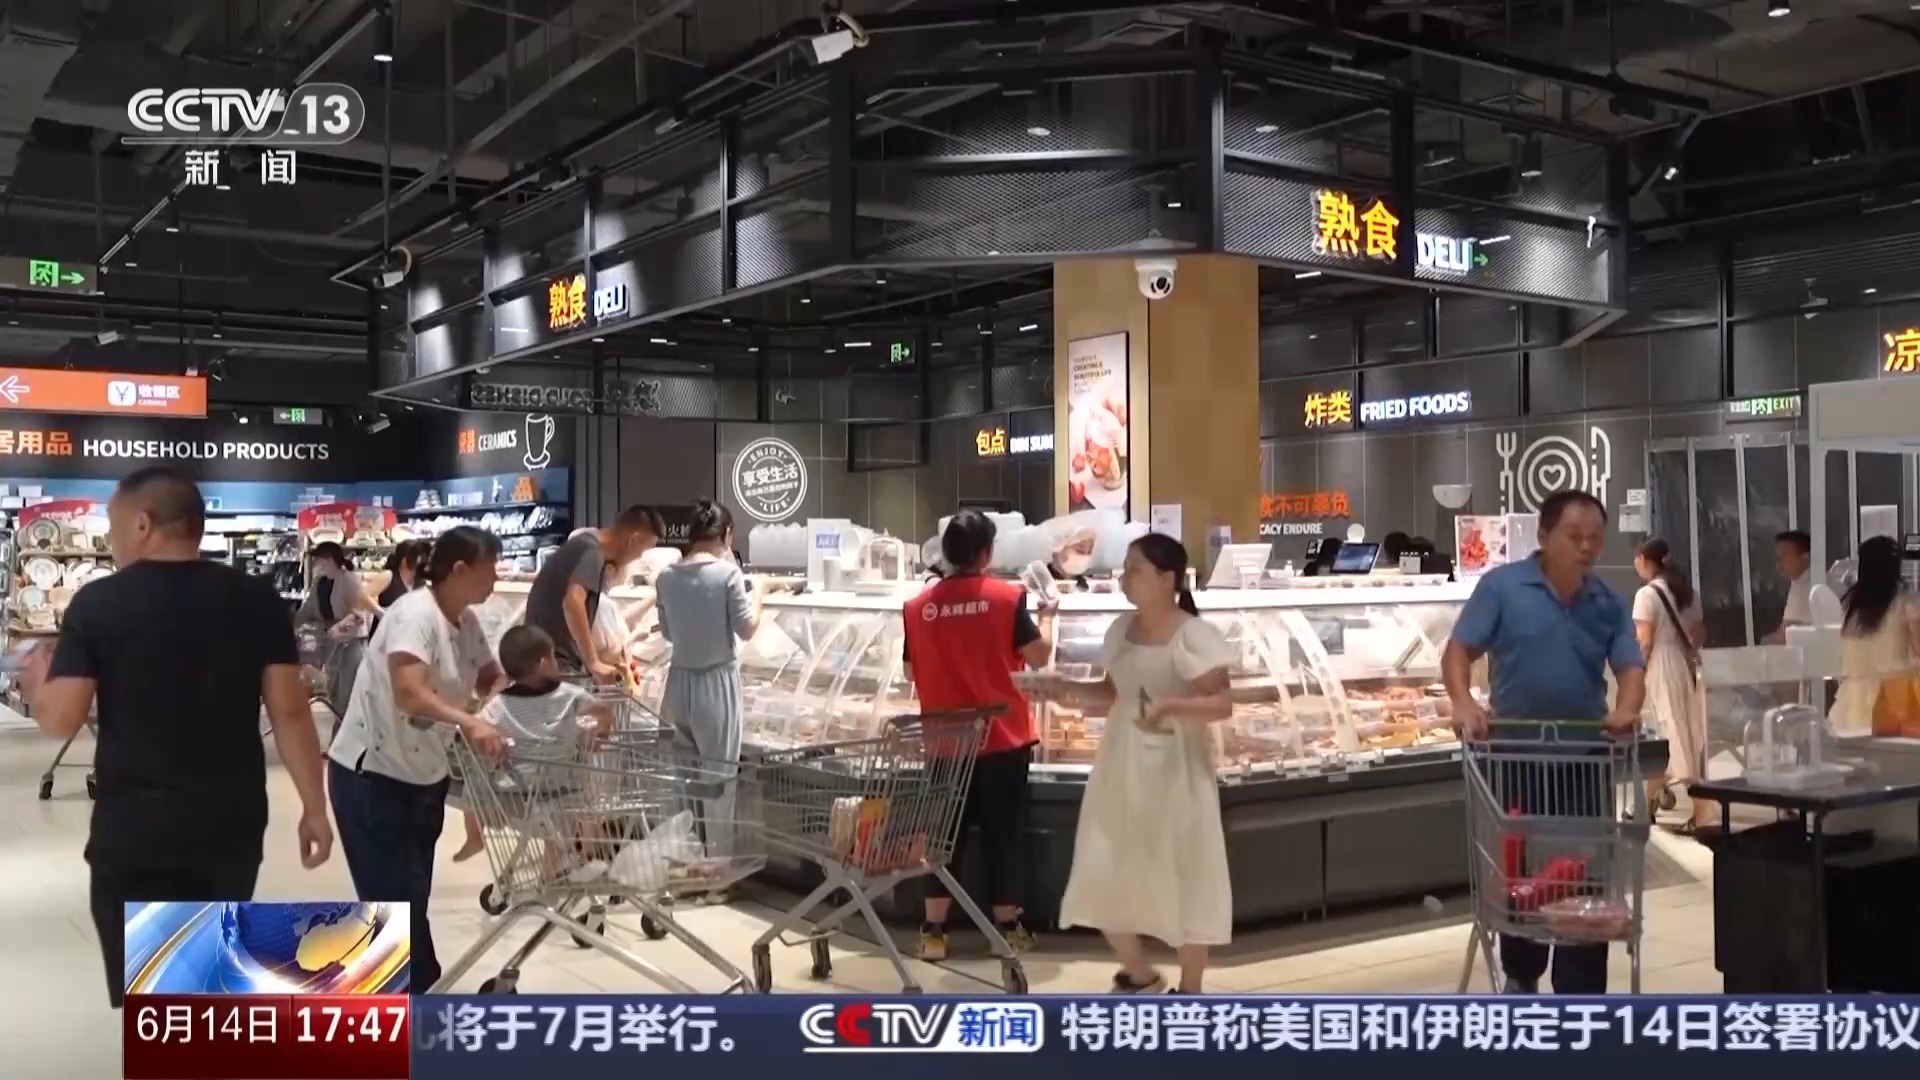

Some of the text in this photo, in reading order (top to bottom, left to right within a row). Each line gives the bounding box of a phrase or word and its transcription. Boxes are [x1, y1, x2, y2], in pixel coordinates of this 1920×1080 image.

[1318, 189, 1400, 260] 熟食
[1416, 232, 1473, 272] DELI
[548, 273, 587, 328] 熟食
[593, 283, 627, 318] DELI
[1304, 391, 1352, 428] 炸类
[1360, 390, 1471, 423] FRIED FOODS
[1773, 397, 1794, 411] EXIT
[83, 439, 329, 460] HOUSEHOLD PRODUCTS
[478, 429, 518, 452] CERAMICS
[976, 428, 1006, 456] 包点
[750, 447, 784, 462] ENJOY
[742, 462, 799, 488] 享受生活
[763, 500, 788, 513] LIFE
[1283, 522, 1323, 535] ENDURE
